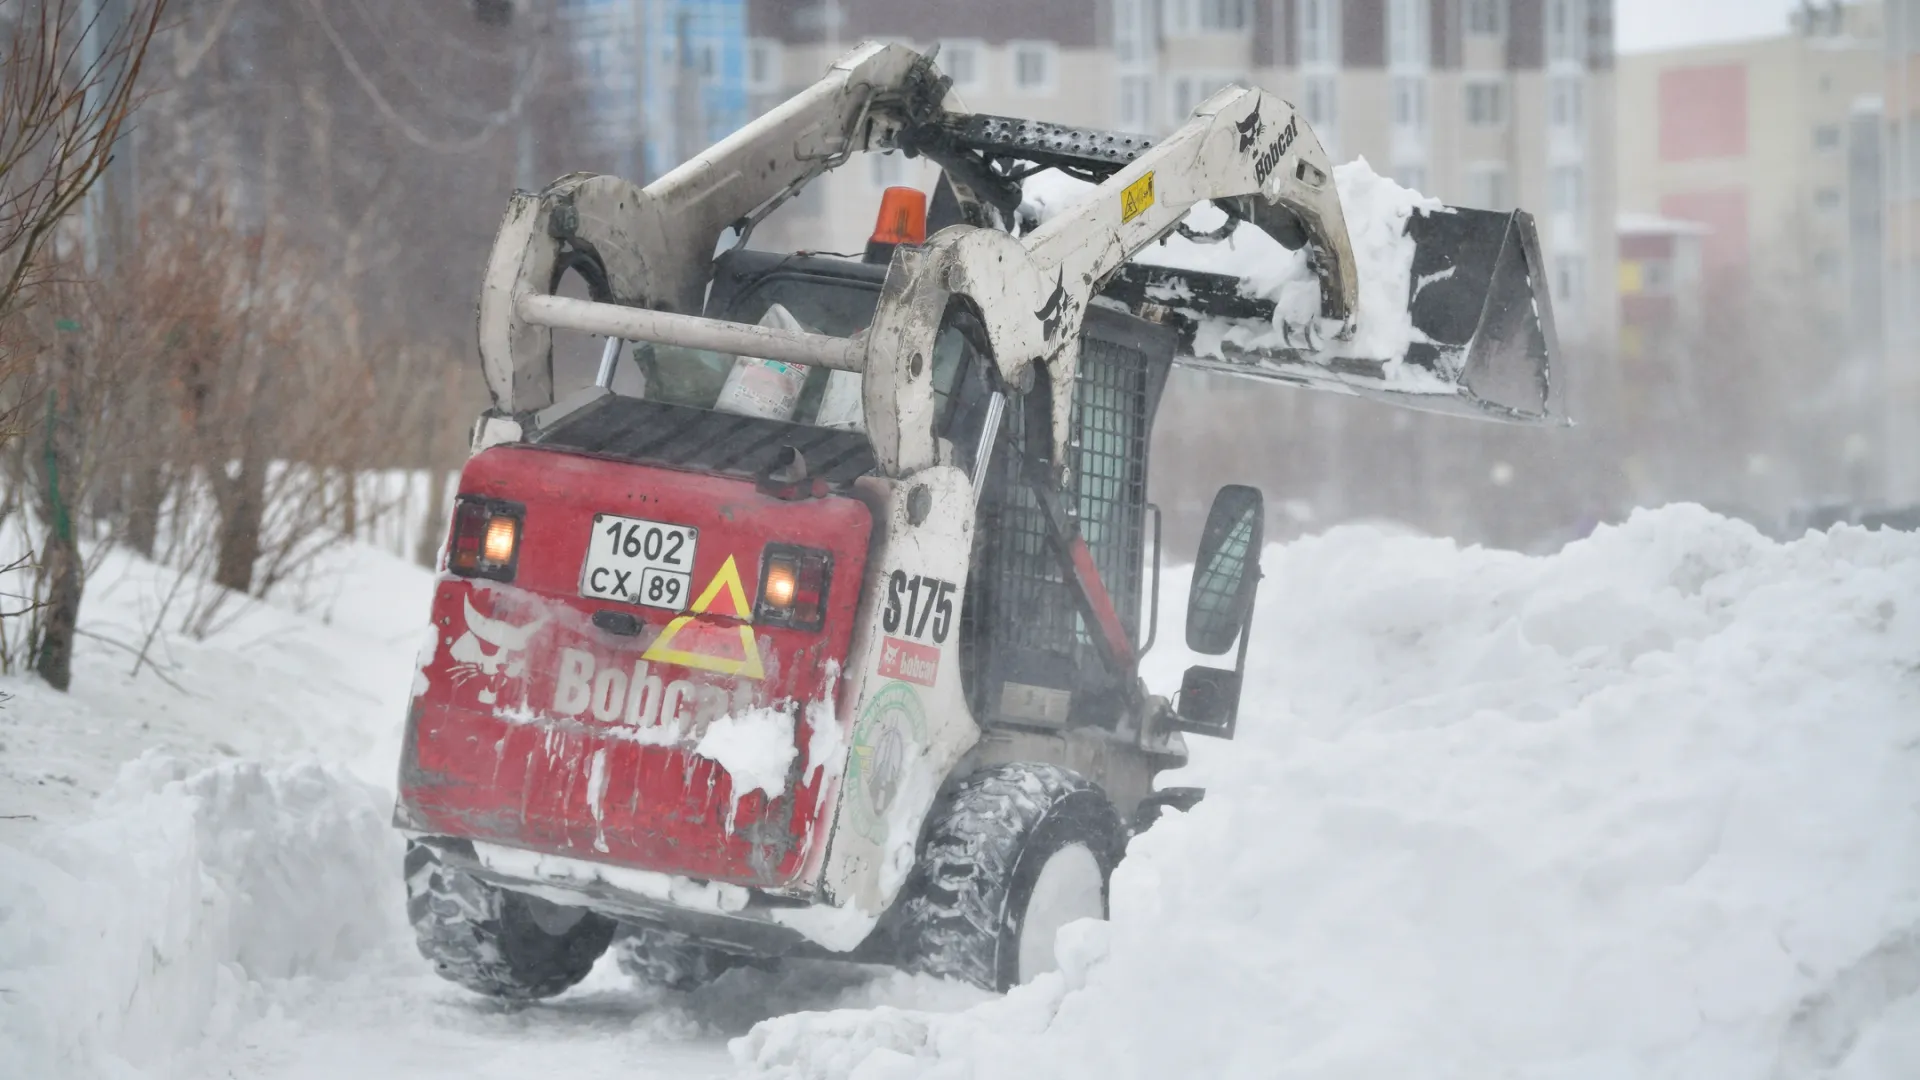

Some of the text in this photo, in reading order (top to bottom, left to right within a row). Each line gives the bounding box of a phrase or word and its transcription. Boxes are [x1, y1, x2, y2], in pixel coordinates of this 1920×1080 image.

[1255, 114, 1298, 188] Bobcat
[606, 522, 684, 565] 1602
[648, 575, 681, 604] 89
[882, 569, 956, 644] S175
